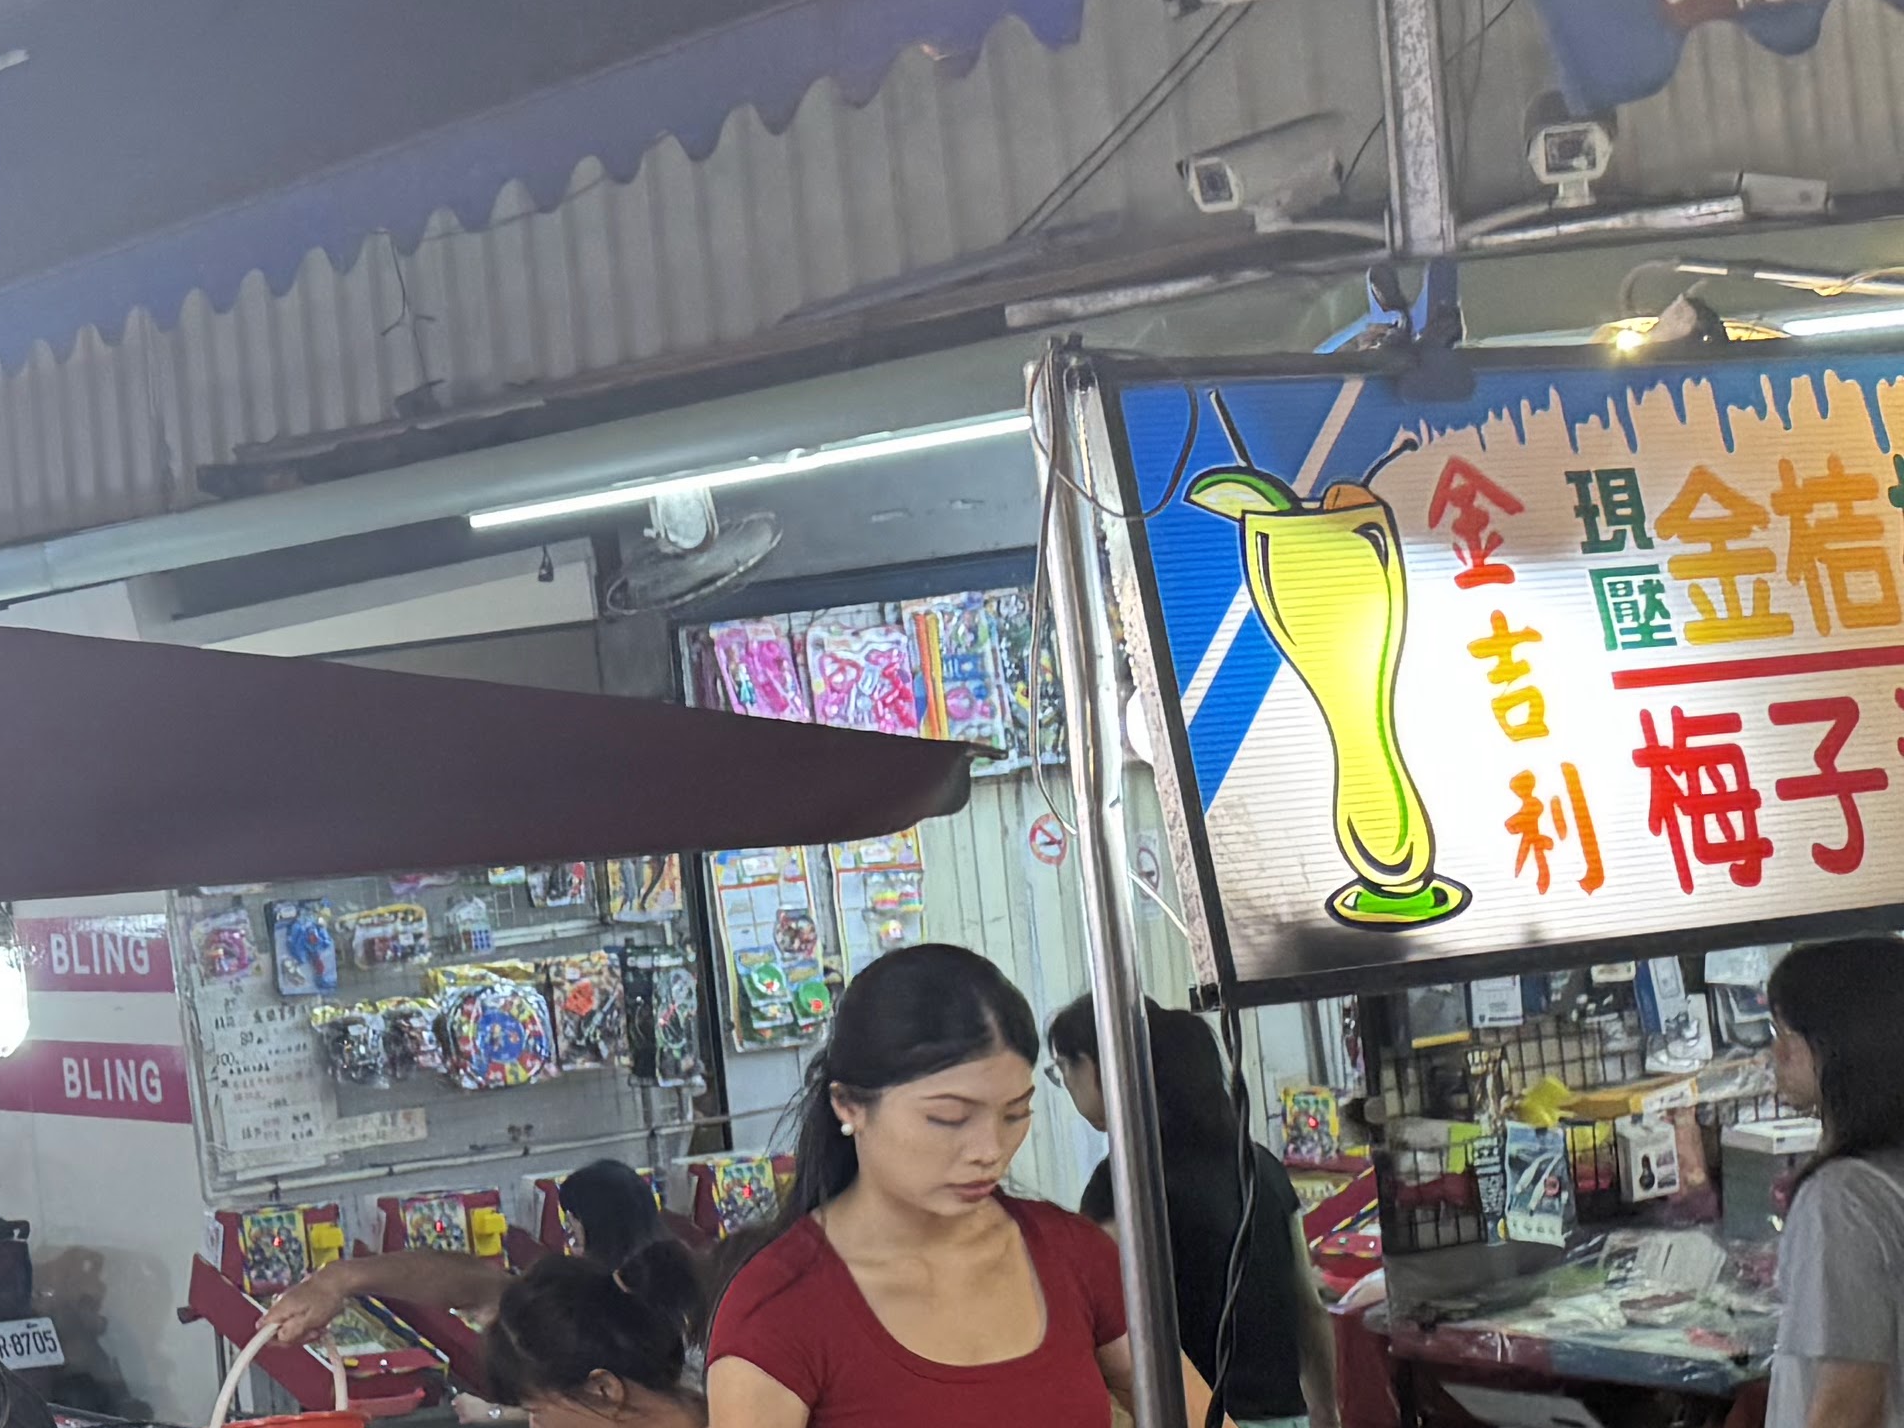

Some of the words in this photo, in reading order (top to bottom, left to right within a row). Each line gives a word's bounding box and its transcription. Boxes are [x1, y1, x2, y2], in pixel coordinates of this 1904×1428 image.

[1573, 468, 1677, 650] 現壓
[1428, 455, 1606, 896] 金吉利
[1632, 696, 1904, 896] 梅子
[50, 933, 151, 974] BLING
[62, 1057, 163, 1104] BLING
